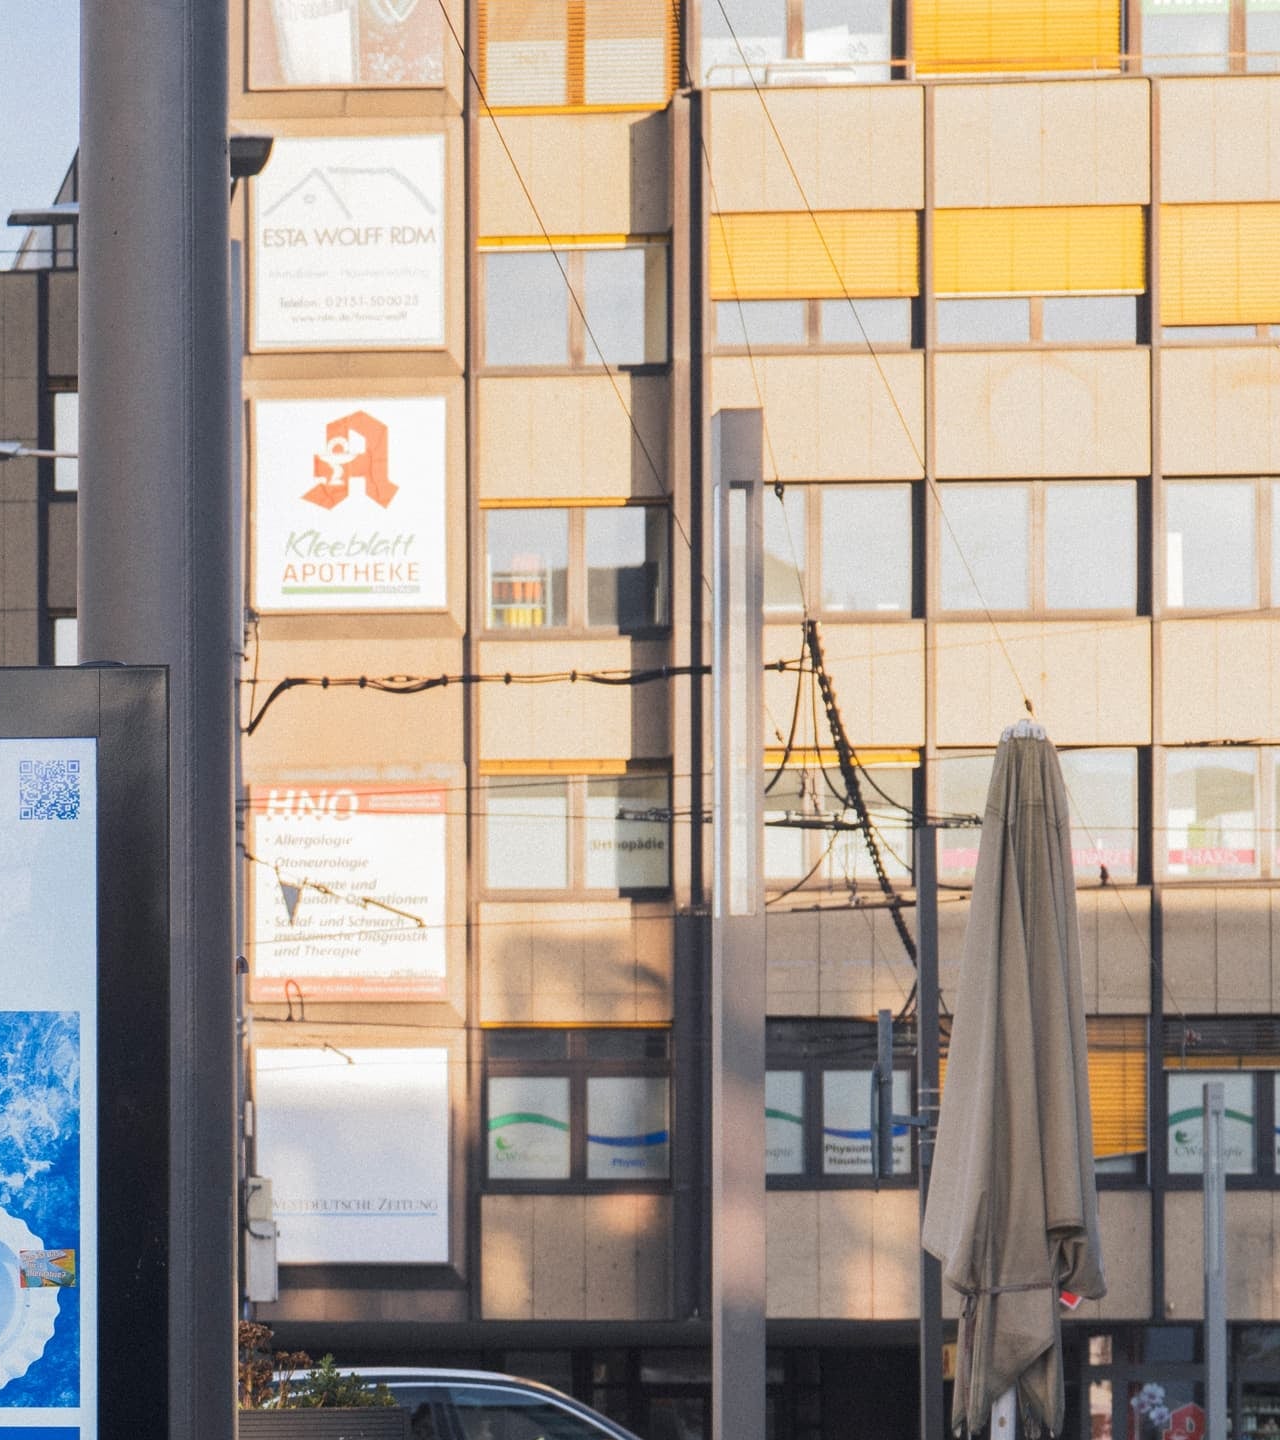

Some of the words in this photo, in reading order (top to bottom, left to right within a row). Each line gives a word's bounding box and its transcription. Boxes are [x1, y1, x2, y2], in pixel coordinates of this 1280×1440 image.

[263, 228, 308, 248] ESTA
[314, 226, 383, 246] WOLFF
[390, 226, 436, 244] RDM
[285, 529, 415, 559] Kleeblatt
[283, 562, 420, 583] APOTHEKE
[267, 789, 359, 821] HNO
[274, 834, 353, 848] Allergologie
[275, 857, 369, 871] Otoneurologie
[351, 878, 377, 890] und
[346, 892, 428, 907] Opationen
[319, 915, 344, 927] und
[359, 931, 428, 946] Diagnostik
[274, 945, 297, 957] und
[304, 945, 361, 959] Therapie
[825, 1144, 905, 1156] Physiotie
[378, 1198, 438, 1211] ZEITUNG
